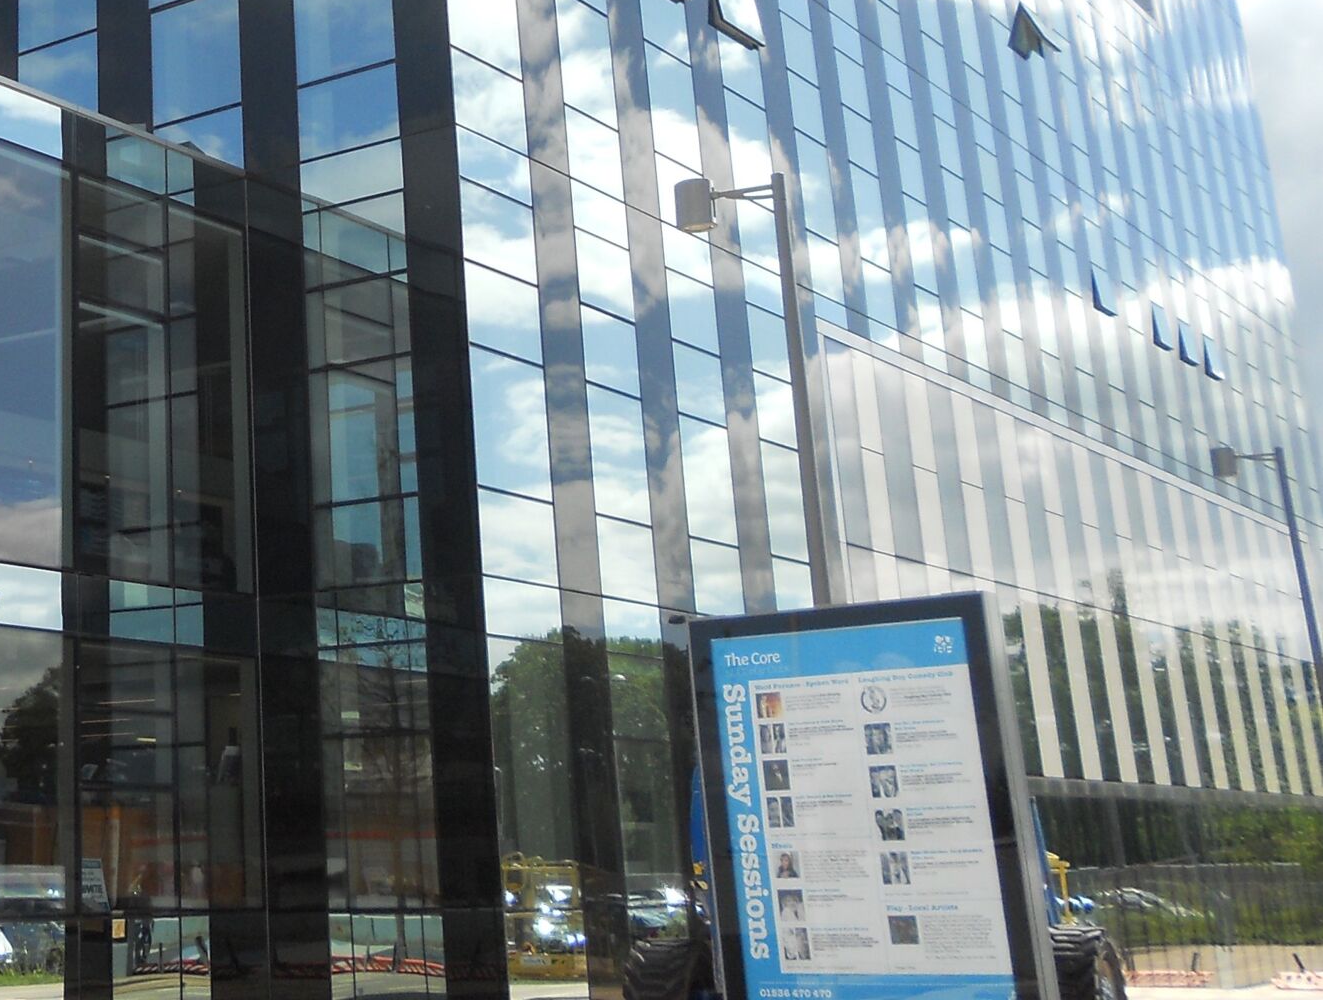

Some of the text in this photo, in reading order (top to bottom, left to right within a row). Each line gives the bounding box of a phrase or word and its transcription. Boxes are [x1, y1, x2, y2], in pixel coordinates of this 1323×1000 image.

[724, 651, 781, 667] The Core
[723, 684, 770, 960] Sunday Sessions
